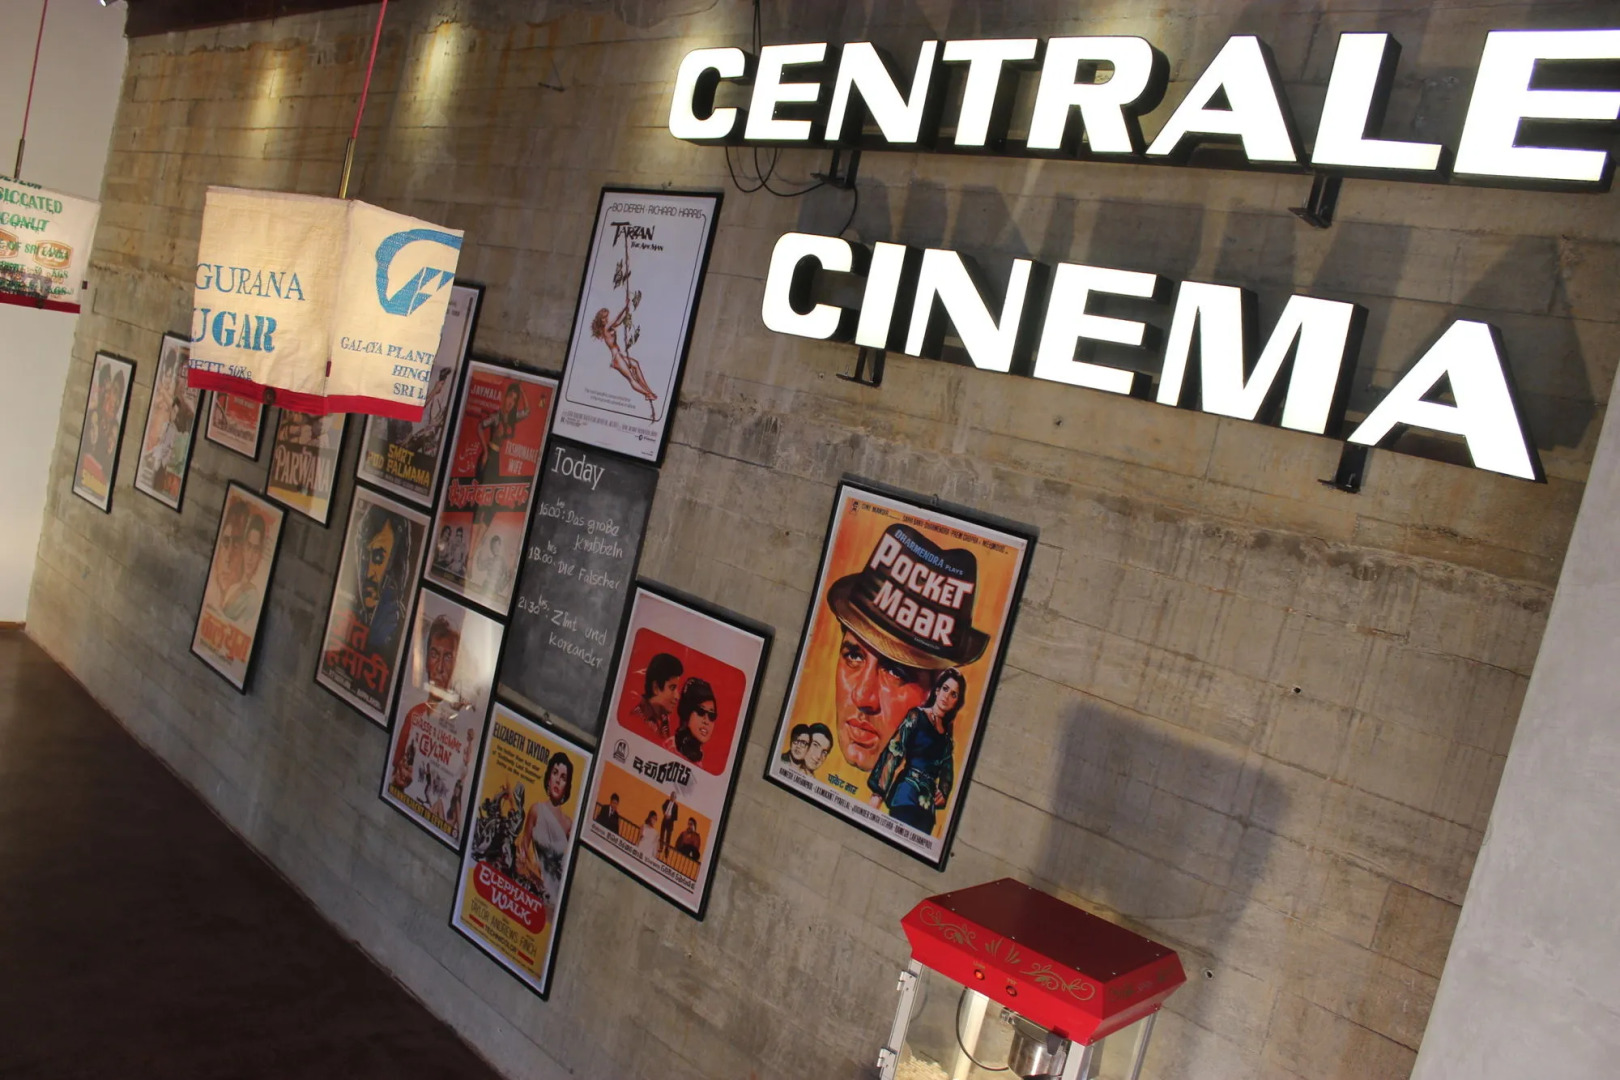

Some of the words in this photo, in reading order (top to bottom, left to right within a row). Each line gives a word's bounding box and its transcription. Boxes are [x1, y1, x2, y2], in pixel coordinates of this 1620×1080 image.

[668, 29, 1620, 182] CENTRALE
[612, 202, 622, 212] BO
[623, 203, 645, 214] DEREK
[648, 204, 677, 217] RICHARD
[678, 207, 702, 219] HARRIS
[761, 231, 1537, 481] CINEMA
[393, 382, 416, 398] SRI
[275, 444, 331, 492] PARWANA
[551, 446, 604, 491] Today
[565, 510, 585, 526] Das
[870, 533, 975, 609] POCKET
[894, 529, 945, 569] DHARMENDRA
[945, 563, 964, 576] PLAYS
[551, 609, 577, 632] Zimt
[585, 627, 608, 646] und
[493, 721, 525, 752] ELIZABETH
[526, 738, 550, 765] TAYLOR
[479, 865, 542, 912] ELEPHANT
[492, 887, 531, 926] WALK
